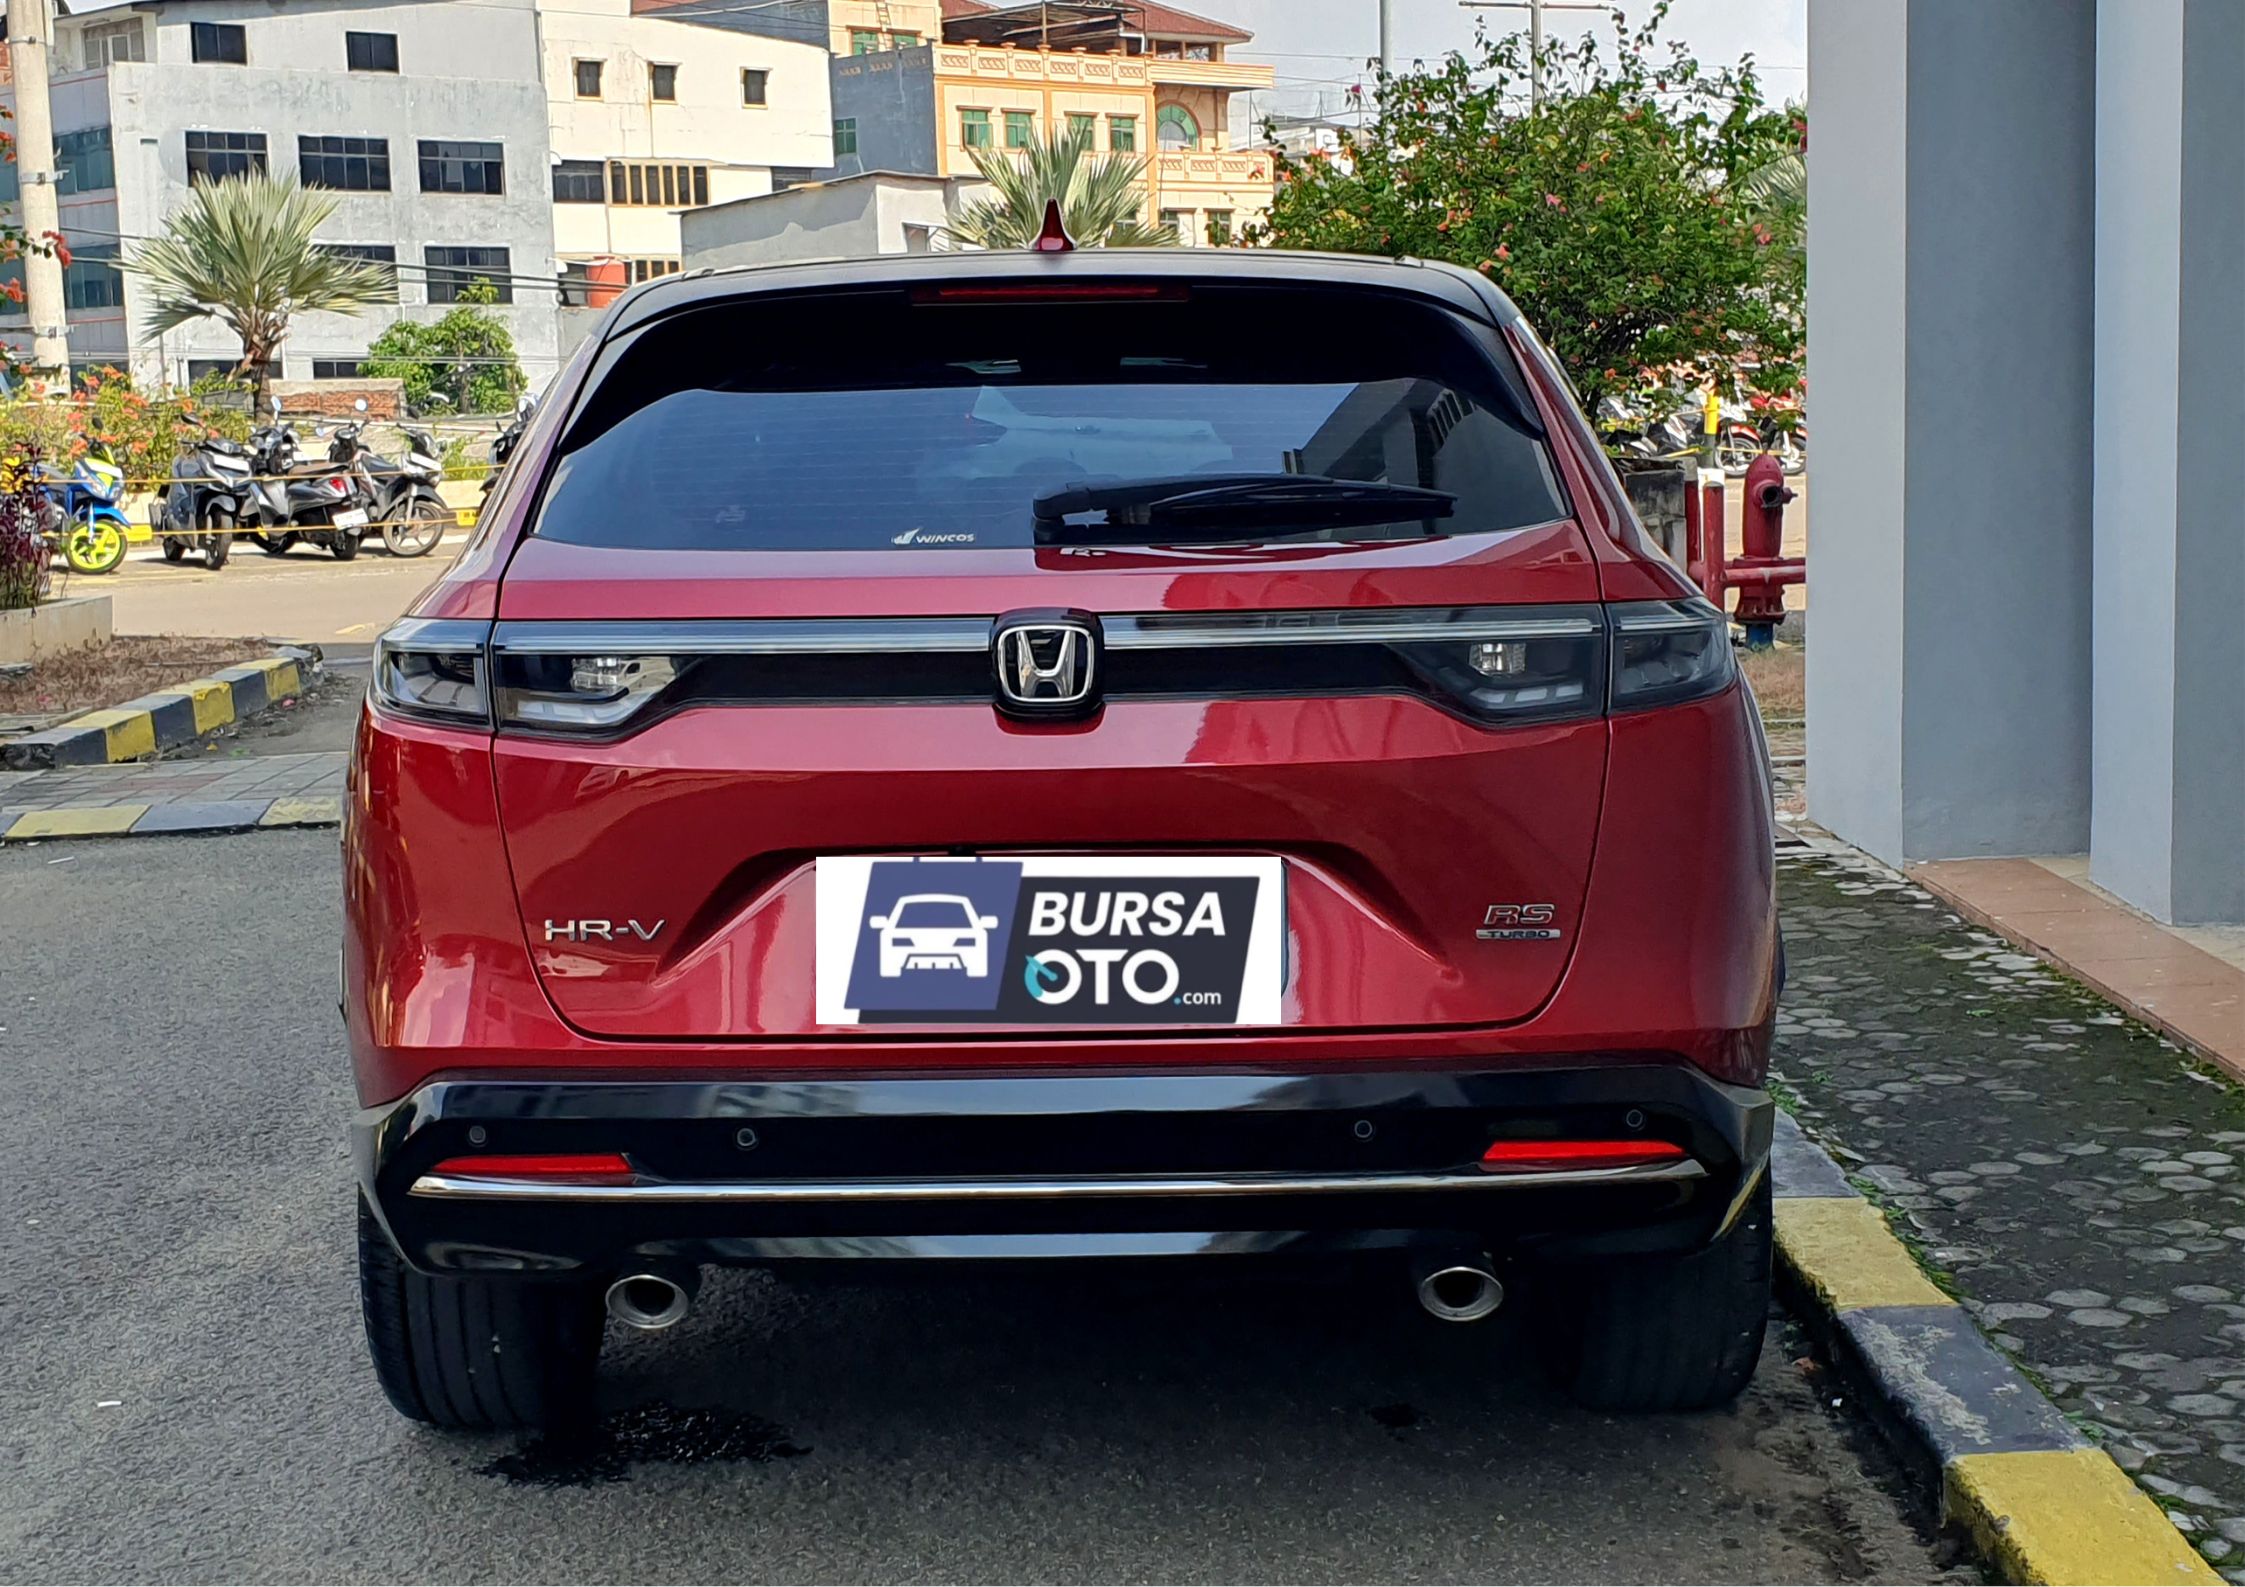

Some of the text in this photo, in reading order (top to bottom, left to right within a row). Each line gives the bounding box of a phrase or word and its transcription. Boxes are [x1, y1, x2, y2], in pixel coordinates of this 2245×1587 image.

[916, 534, 975, 543] WINCOS
[1483, 904, 1555, 925] RS
[544, 919, 665, 941] HR-V
[1485, 929, 1553, 939] TURBO
